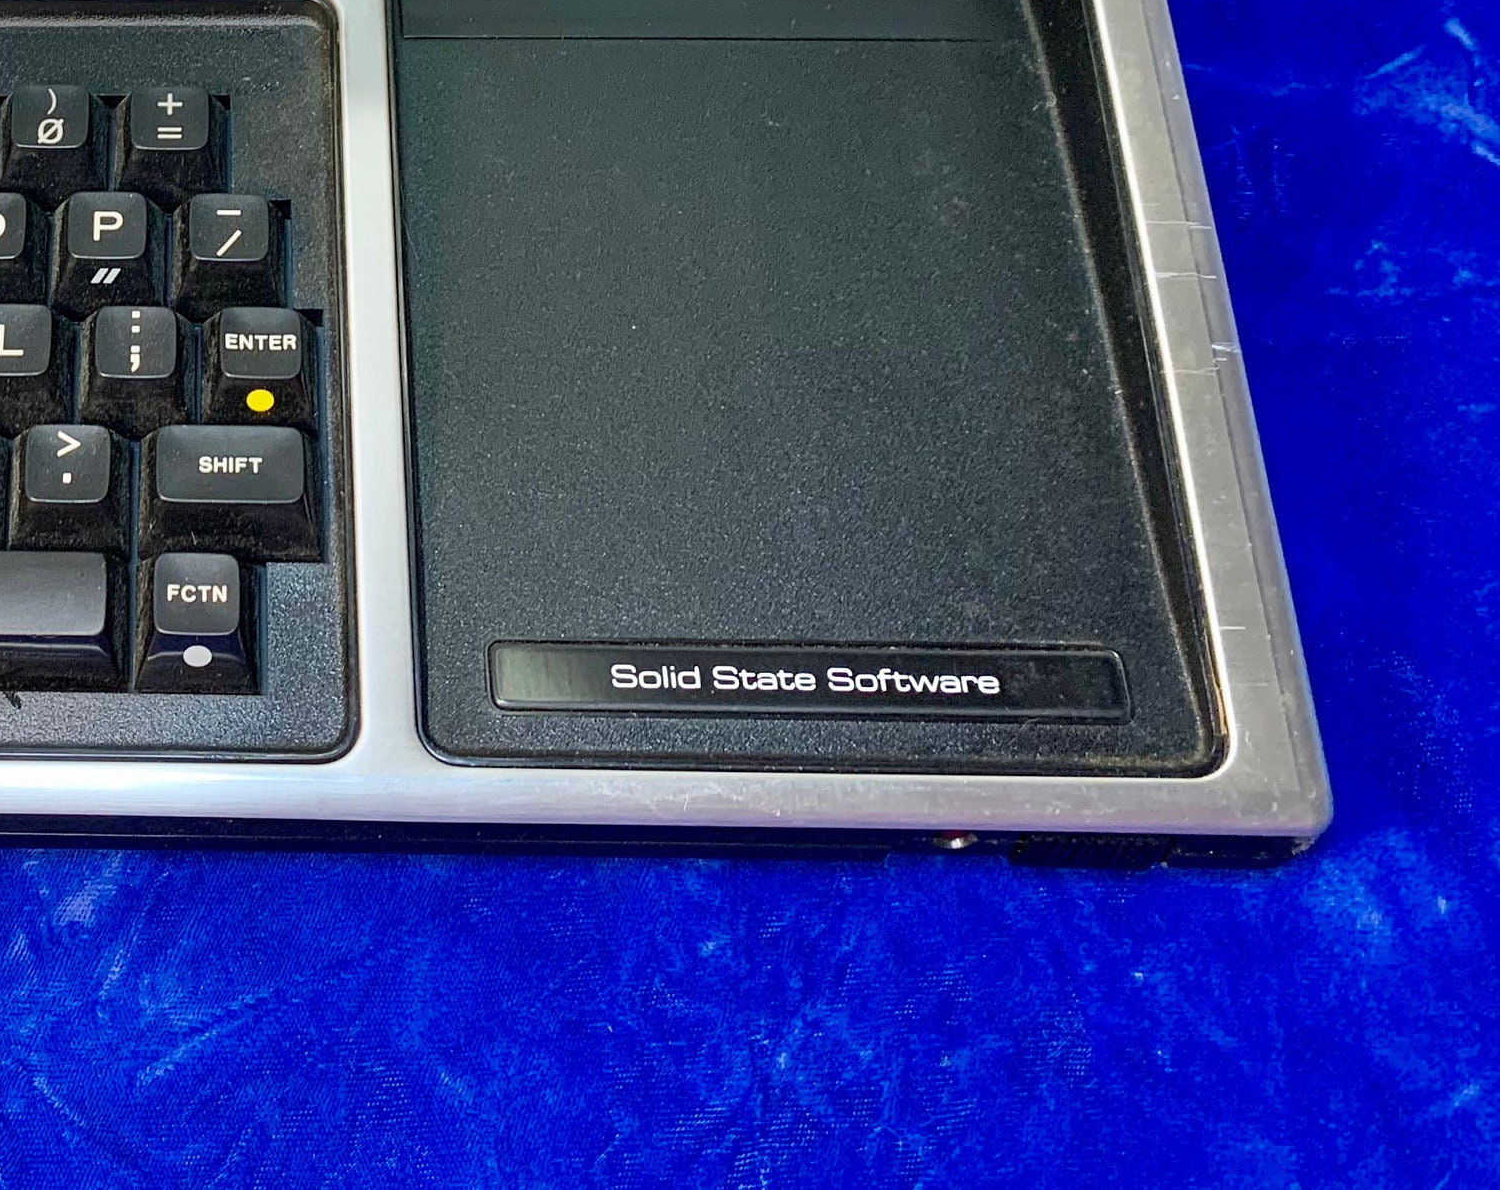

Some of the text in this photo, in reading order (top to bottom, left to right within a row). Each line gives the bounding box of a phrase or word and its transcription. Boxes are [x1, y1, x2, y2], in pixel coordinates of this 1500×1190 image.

[47, 88, 57, 115] )
[157, 93, 183, 116] +
[157, 127, 183, 139] =
[93, 210, 124, 241] P
[216, 229, 242, 257] /
[224, 333, 297, 351] ENTER
[57, 430, 81, 457] >
[198, 456, 263, 474] SHIFT
[167, 583, 228, 603] FCTN
[610, 664, 1000, 695] Solid State Software
